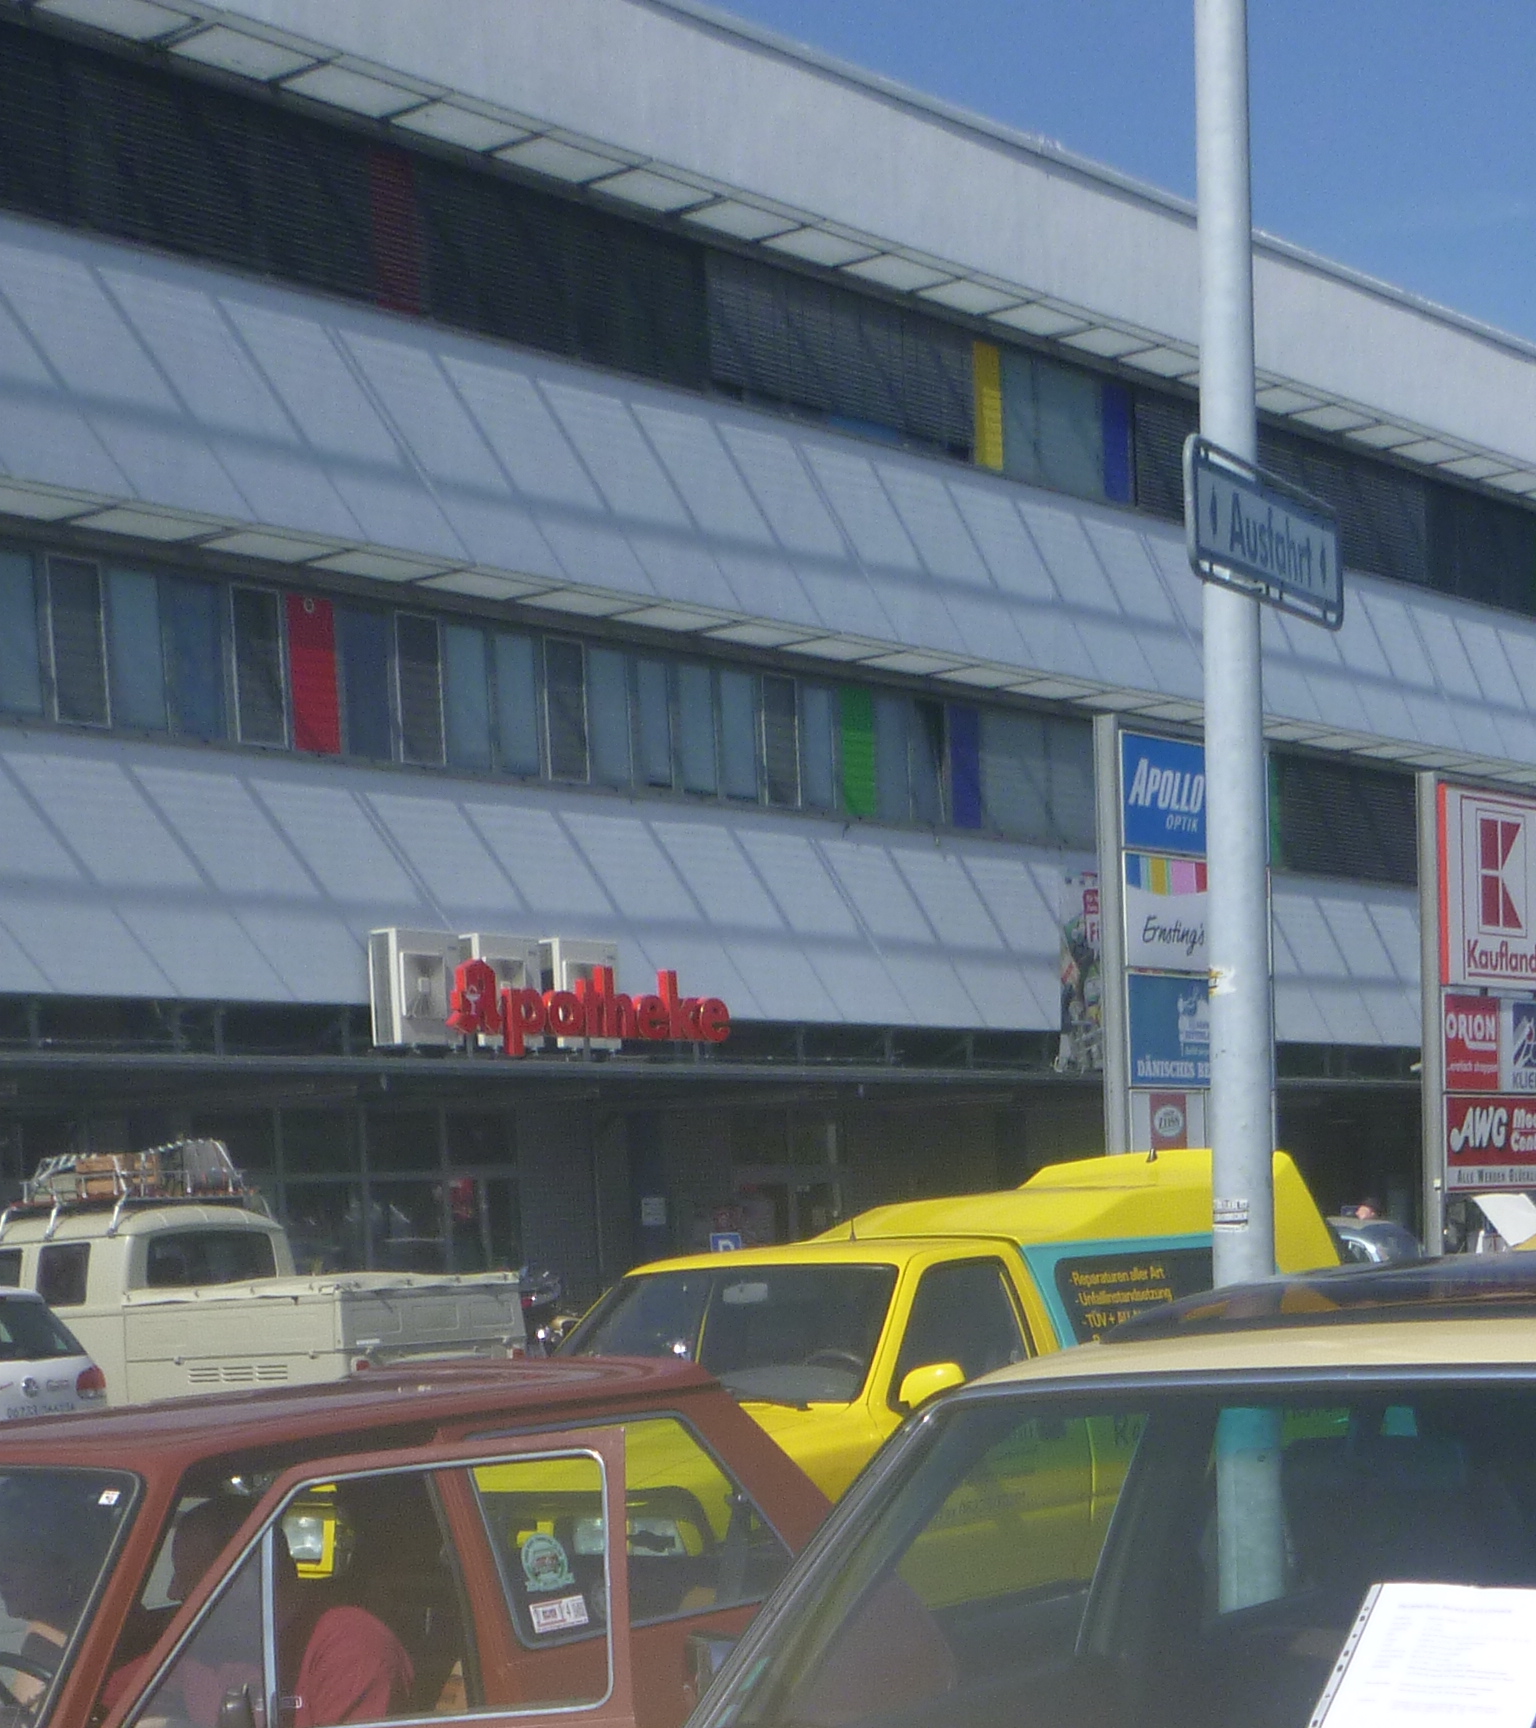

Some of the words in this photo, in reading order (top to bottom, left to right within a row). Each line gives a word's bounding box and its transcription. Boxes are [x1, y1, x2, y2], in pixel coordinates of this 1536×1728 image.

[1128, 757, 1204, 814] APOLLO
[1166, 814, 1199, 832] OPTIK
[1142, 916, 1205, 956] Ernsting's
[446, 958, 729, 1057] Apotheke
[1446, 1013, 1496, 1051] ORION
[1137, 1056, 1195, 1078] DÄNISCHES
[1450, 1106, 1508, 1153] AWG
